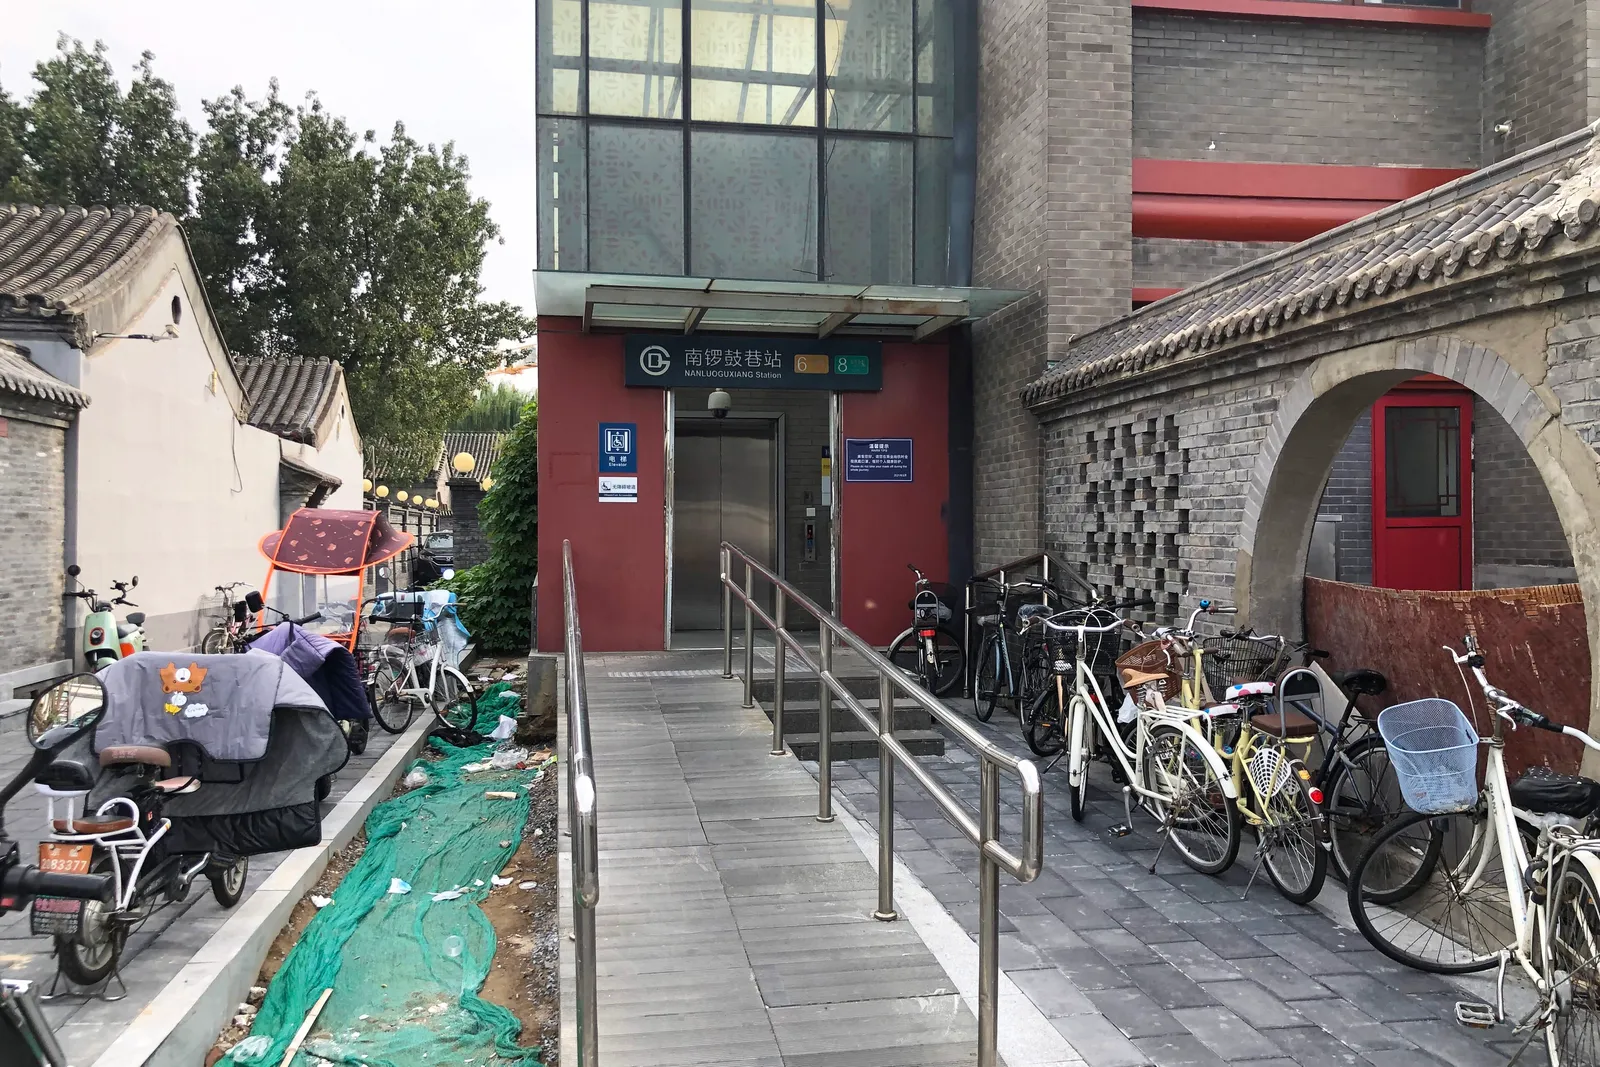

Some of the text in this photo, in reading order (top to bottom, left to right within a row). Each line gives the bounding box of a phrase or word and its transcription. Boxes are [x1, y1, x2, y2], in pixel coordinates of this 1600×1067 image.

[684, 347, 782, 368] 南锣鼓巷站
[797, 356, 807, 372] 6
[837, 357, 847, 373] 8
[684, 370, 782, 379] NANLUOGUXIANG Station
[1489, 782, 1498, 816] GIANT
